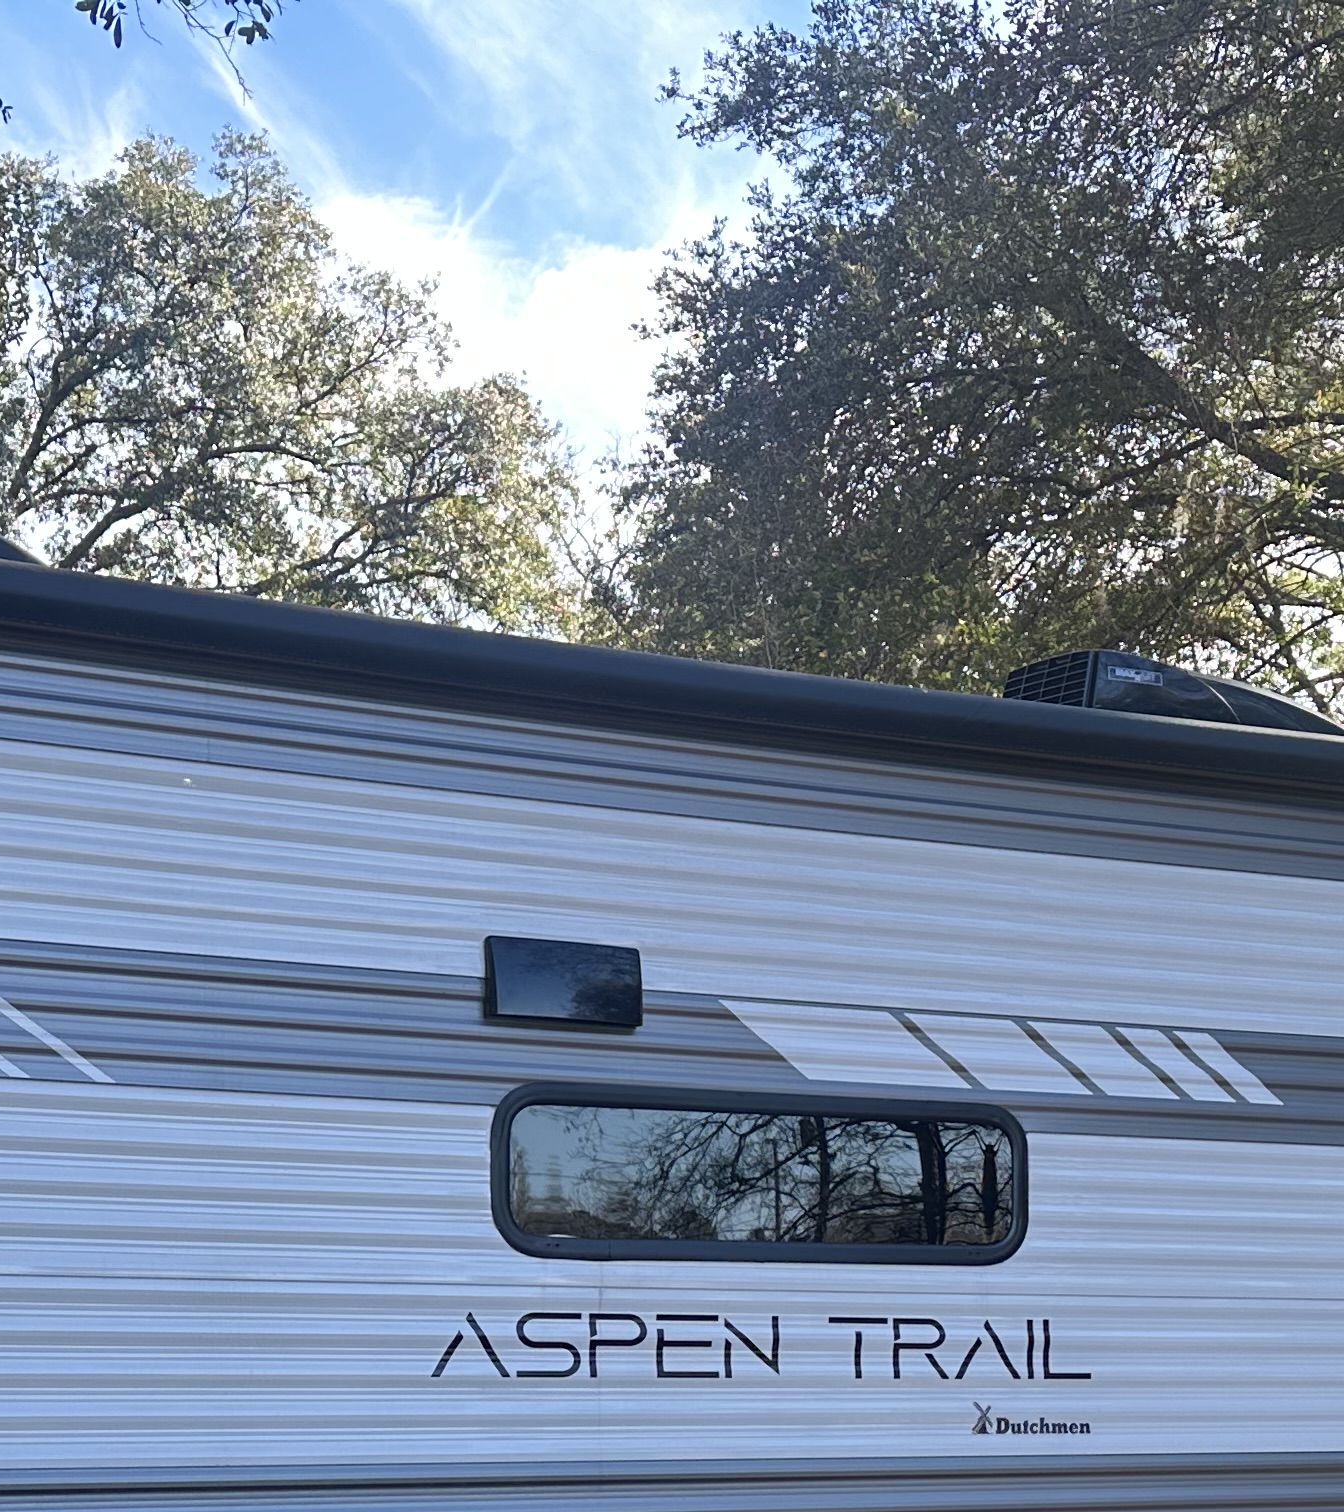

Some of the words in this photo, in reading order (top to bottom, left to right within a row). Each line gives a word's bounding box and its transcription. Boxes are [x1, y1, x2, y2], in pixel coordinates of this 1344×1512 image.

[431, 1311, 780, 1379] ASPEN
[828, 1316, 1092, 1379] TRAIL
[996, 1417, 1091, 1434] Dutchmen
